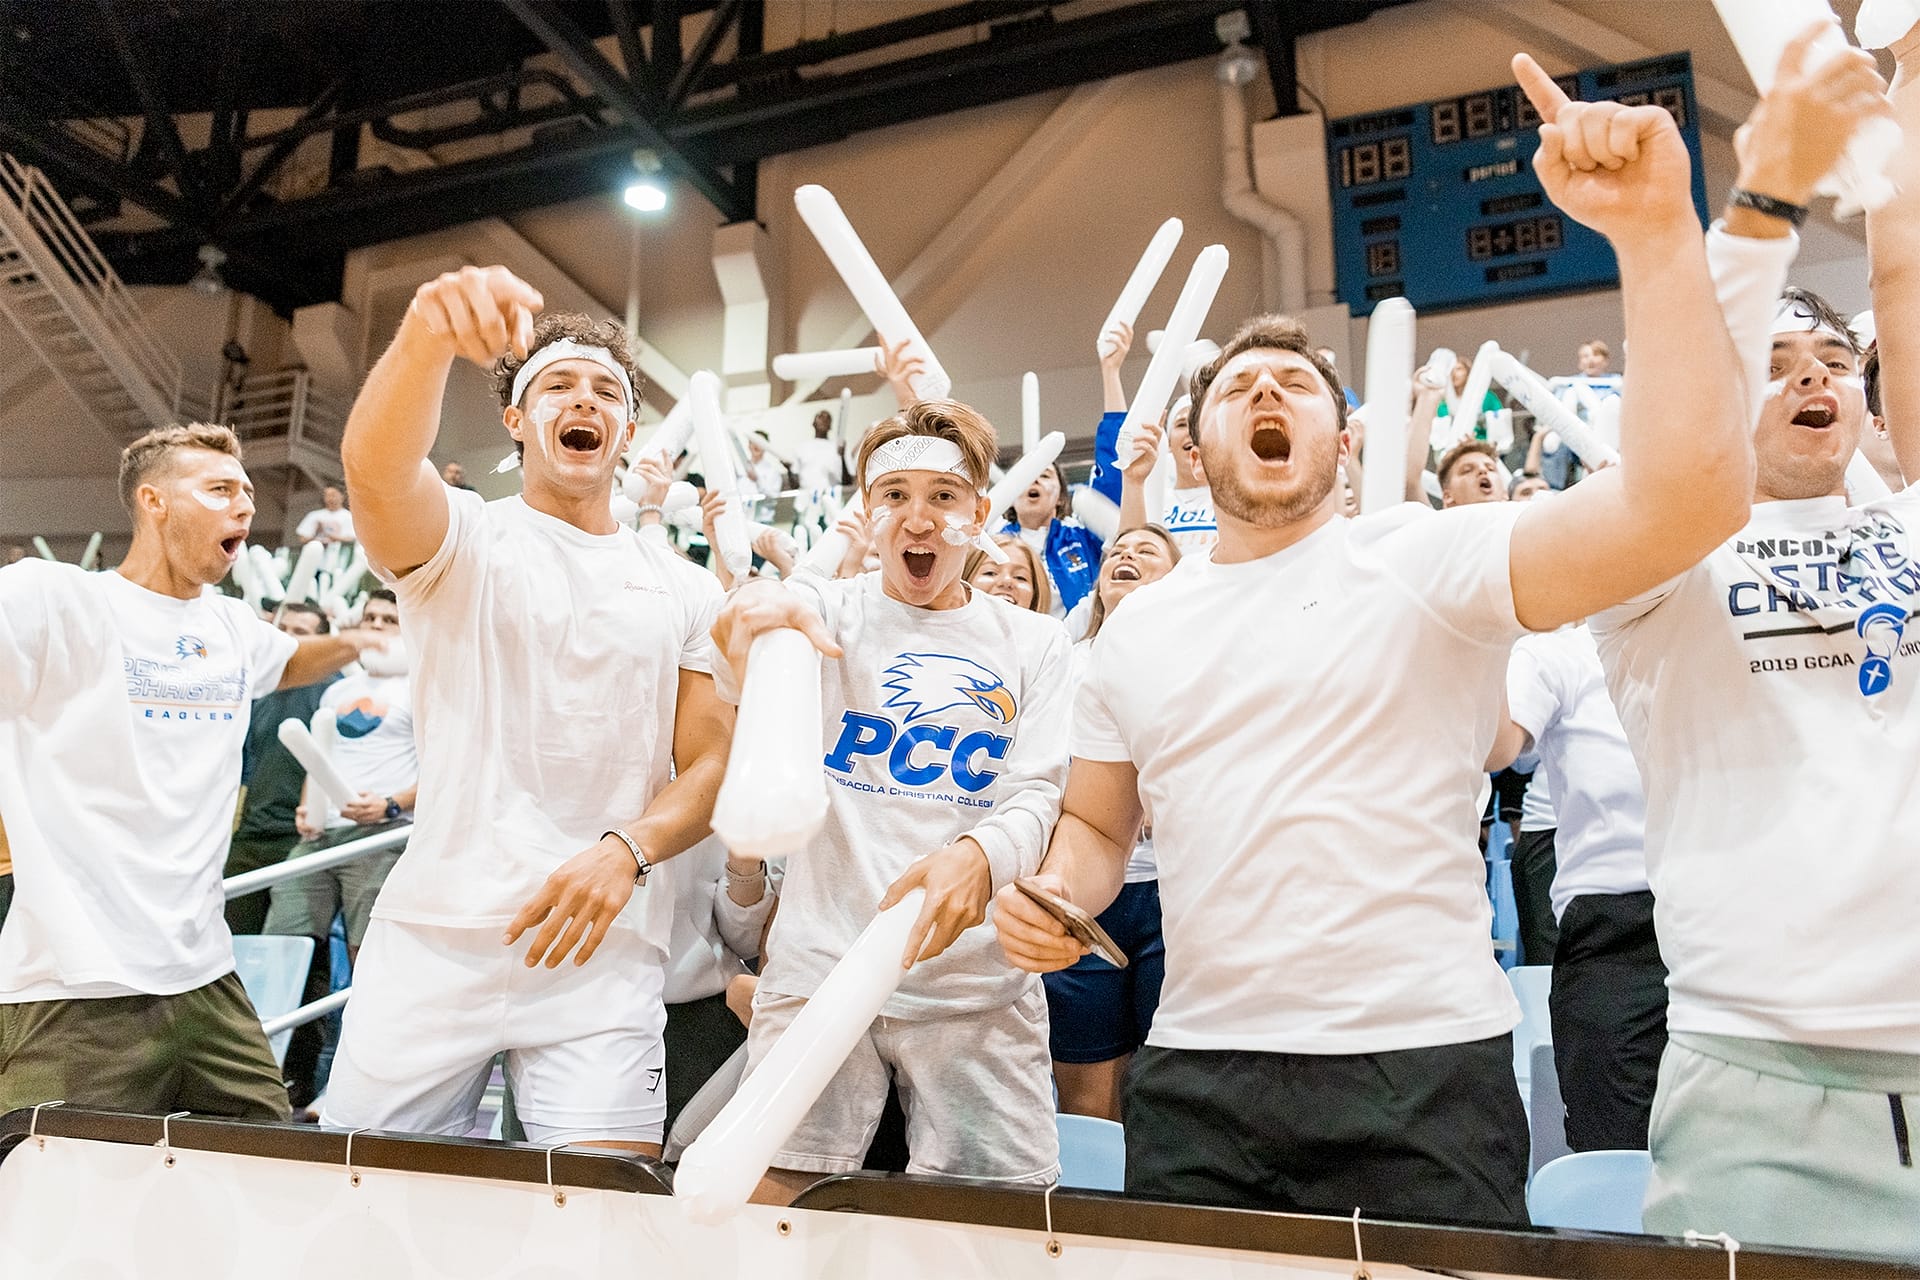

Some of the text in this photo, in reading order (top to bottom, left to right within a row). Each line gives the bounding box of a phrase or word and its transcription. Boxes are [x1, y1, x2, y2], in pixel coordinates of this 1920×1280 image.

[1749, 652, 1855, 674] 2019 GCAA
[823, 709, 1014, 793] PCC
[889, 787, 954, 803] CHRISTIAN
